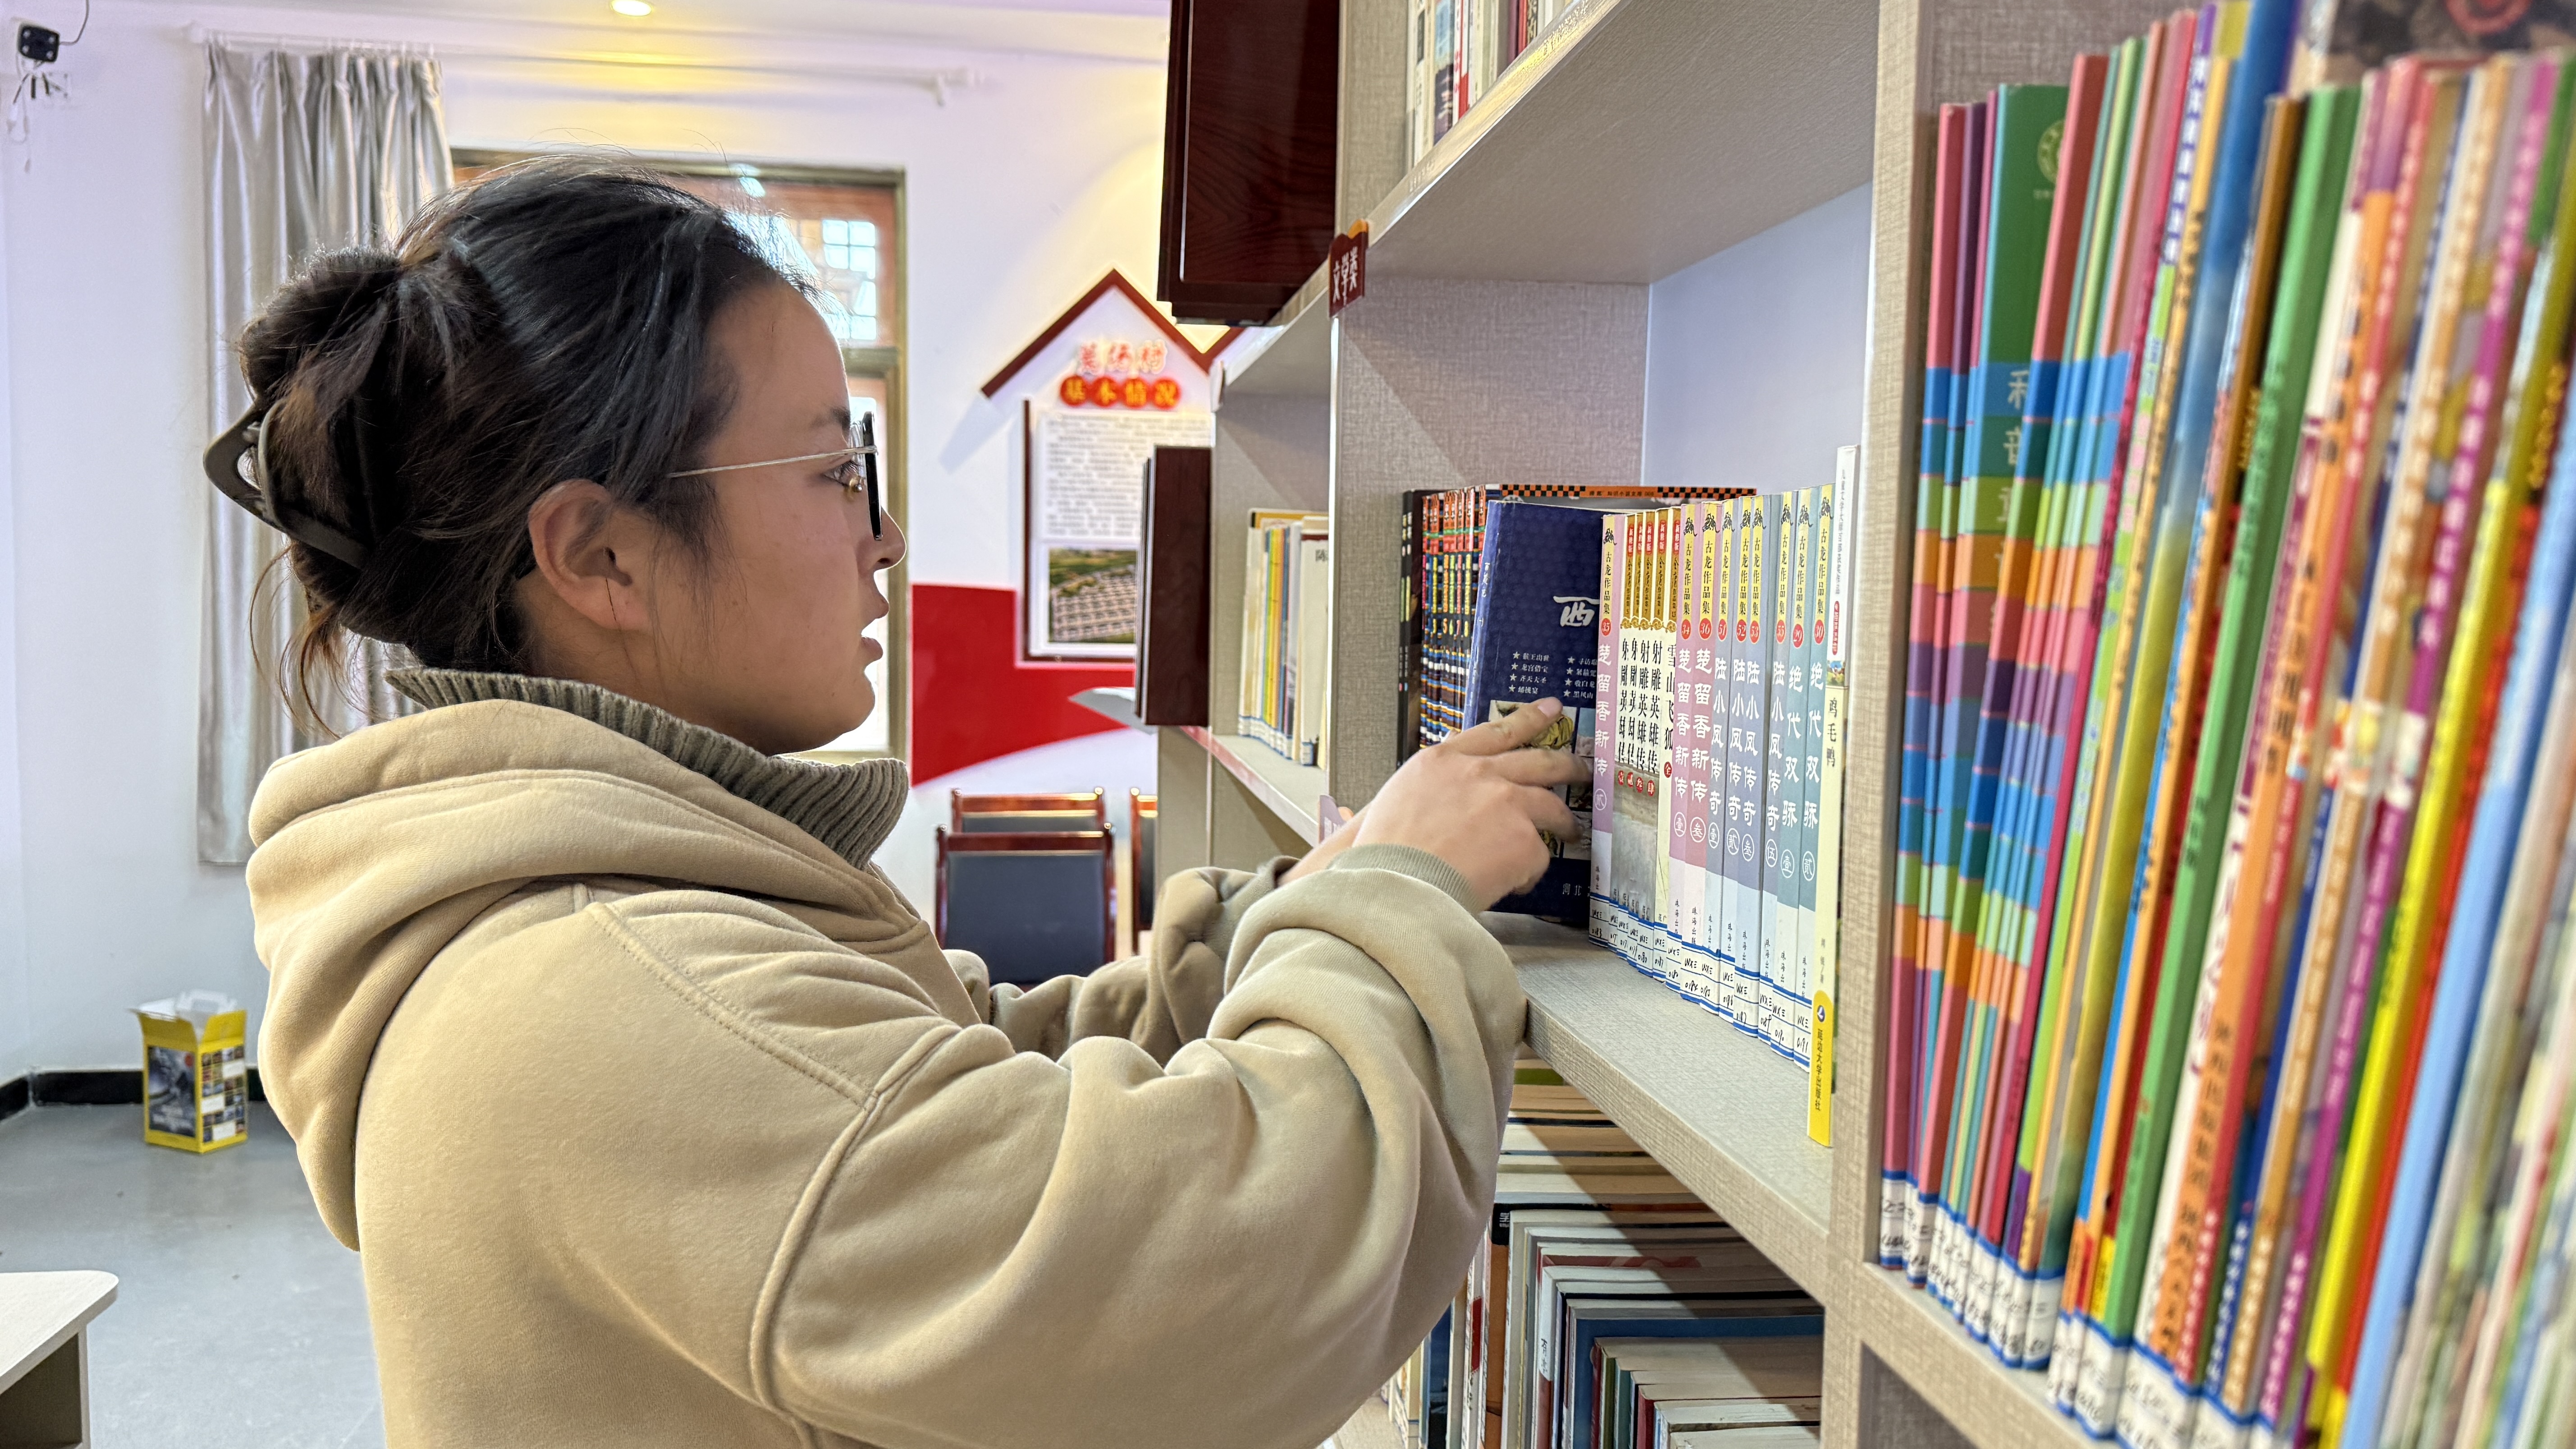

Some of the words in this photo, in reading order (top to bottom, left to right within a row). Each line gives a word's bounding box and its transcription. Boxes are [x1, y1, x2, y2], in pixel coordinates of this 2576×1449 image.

[1333, 246, 1358, 306] 文学类
[1064, 380, 1178, 408] 基本情况
[1553, 595, 1600, 627] 西
[1604, 551, 1612, 615] 古龙作品集
[1684, 543, 1692, 616] 古龙作品集
[1702, 541, 1713, 614] 古龙作品集
[1721, 539, 1730, 615] 古龙作品集
[1739, 538, 1749, 616] 古龙作品集
[1752, 537, 1762, 616] 古龙作品集
[1779, 534, 1789, 615] 古龙作品集
[1795, 535, 1806, 620] 古龙作品集
[1817, 528, 1827, 615] 古龙作品集
[1520, 675, 1547, 684] 齐天大圣
[1522, 663, 1549, 673] 龙宫借宝
[1573, 690, 1593, 699] 黑风山
[1593, 644, 1612, 777] 楚留香新传
[1618, 638, 1629, 764] 射雕英雄传
[1627, 637, 1638, 765] 射雕英雄传
[1636, 639, 1650, 770] 射雕英雄传
[1647, 640, 1663, 774] 射雕英雄传
[1664, 643, 1676, 751] 雪山飞狐
[1674, 648, 1693, 799] 楚留香新传
[1691, 648, 1712, 804] 楚留香新传
[1709, 657, 1727, 815] 陆小凤传奇
[1728, 658, 1746, 822] 陆小凤传奇
[1743, 660, 1760, 827] 陆小凤传奇
[1766, 661, 1785, 832] 陆小凤传奇
[1782, 665, 1803, 828] 绝代双骄
[1804, 662, 1824, 829] 绝代双骄
[1826, 697, 1838, 768] 鸡毛鸭
